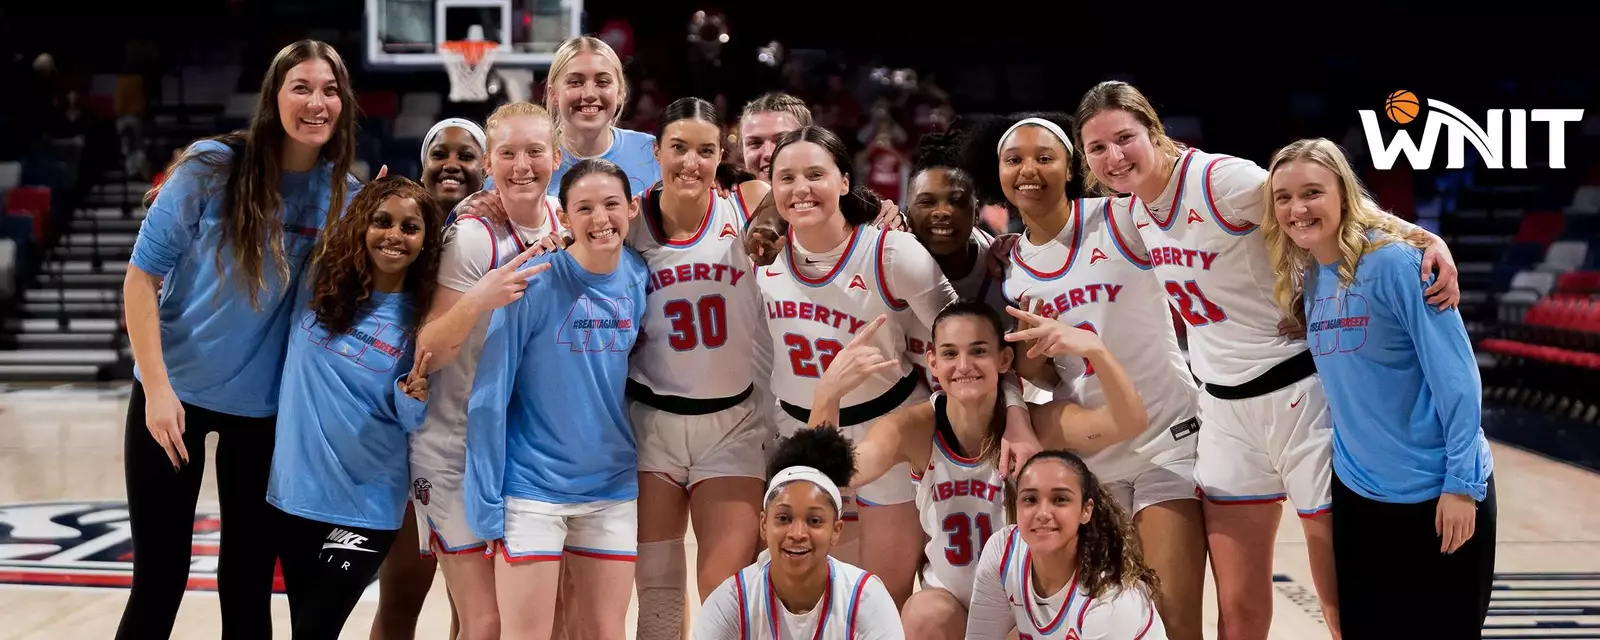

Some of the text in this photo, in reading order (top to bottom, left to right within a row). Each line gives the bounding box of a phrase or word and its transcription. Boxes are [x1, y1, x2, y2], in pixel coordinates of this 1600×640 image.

[1148, 246, 1219, 271] IBERTY
[767, 301, 867, 334] LIBERTY
[1041, 284, 1123, 318] BERTY
[1165, 279, 1228, 327] 21
[663, 293, 728, 352] 30
[932, 479, 1001, 502] IBERT
[326, 527, 369, 548] NIKE
[942, 512, 993, 567] 31
[319, 552, 351, 571] IR
